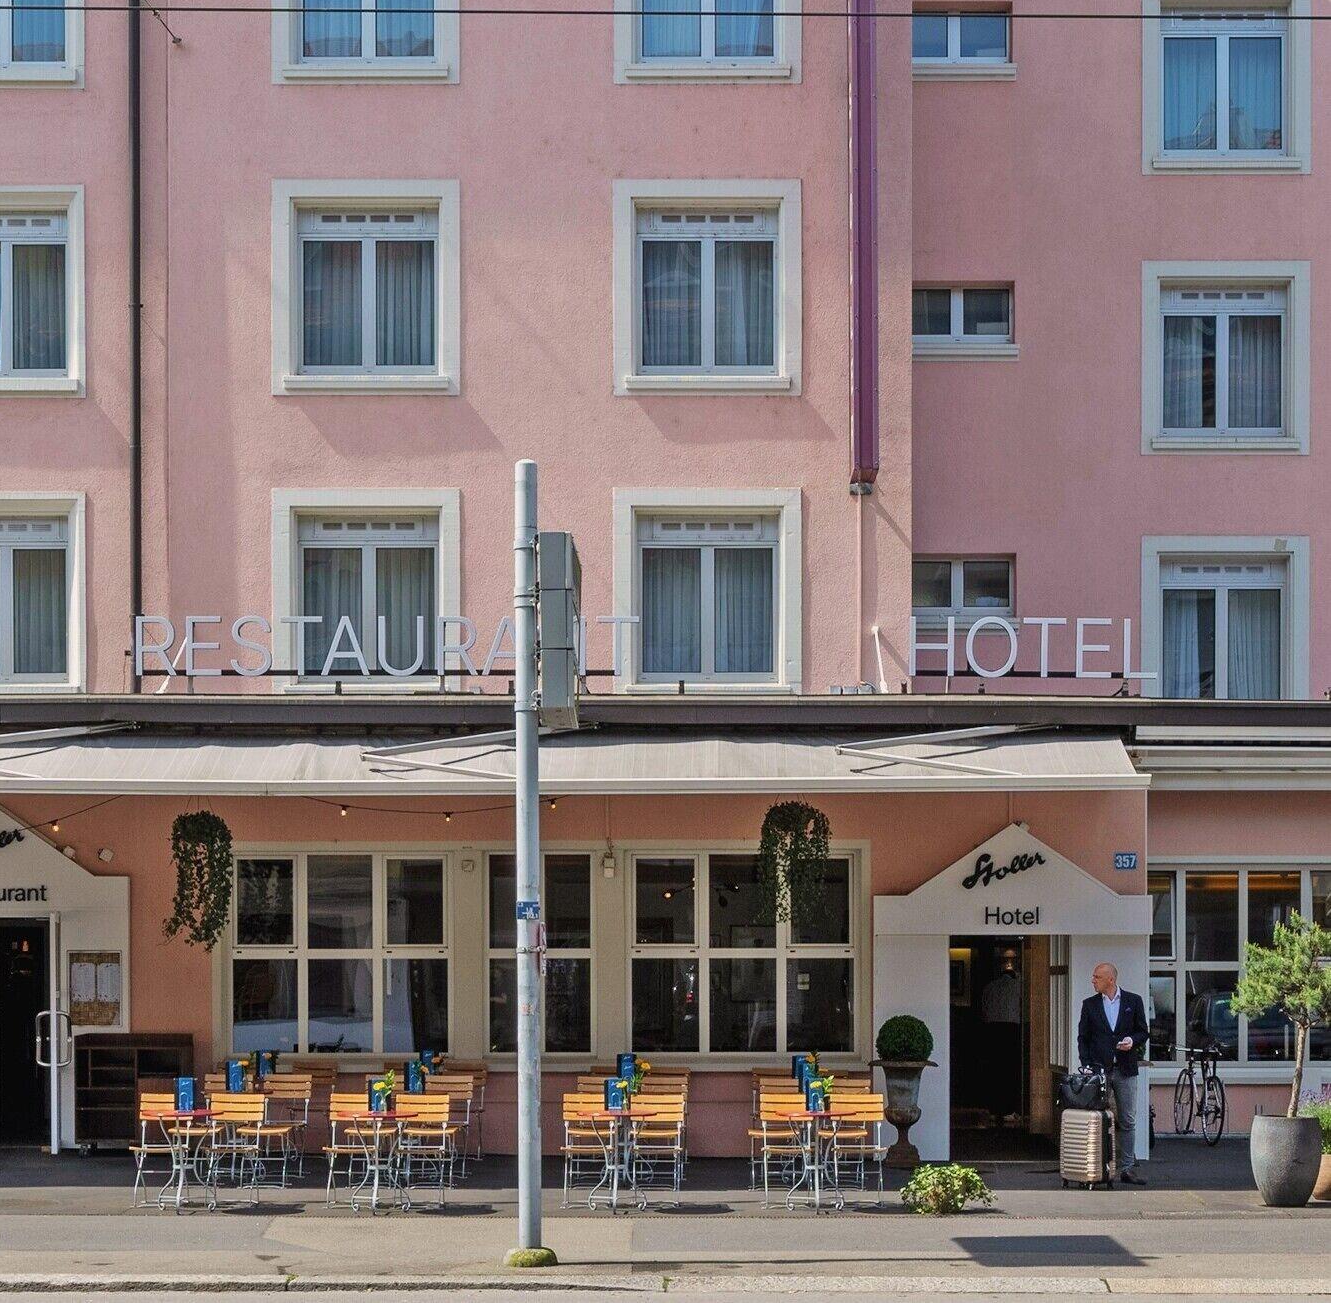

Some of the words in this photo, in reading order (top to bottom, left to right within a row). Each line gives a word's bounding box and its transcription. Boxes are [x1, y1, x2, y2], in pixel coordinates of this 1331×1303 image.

[134, 614, 641, 677] RESTAURAT
[908, 615, 1158, 679] HOTEL
[961, 851, 1046, 889] Stoller
[1114, 854, 1137, 869] 357
[984, 906, 1041, 926] Hotel
